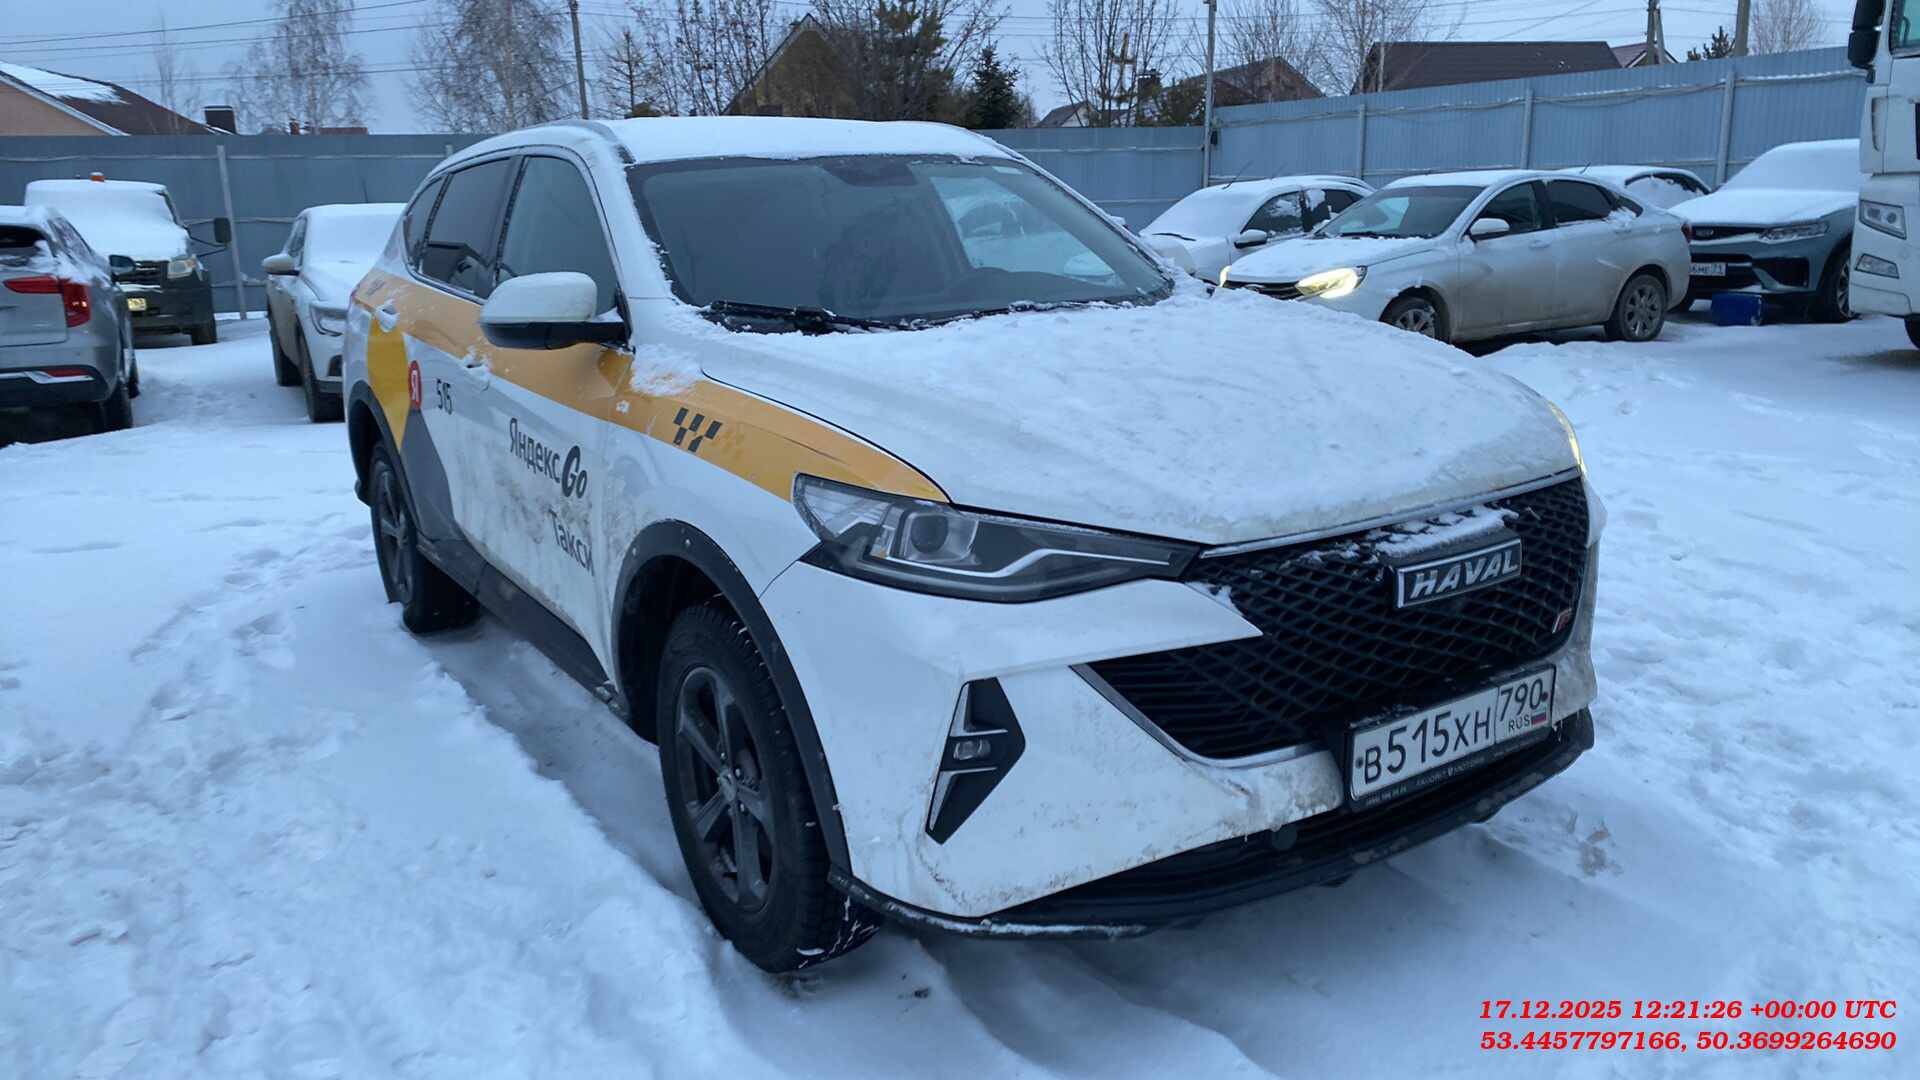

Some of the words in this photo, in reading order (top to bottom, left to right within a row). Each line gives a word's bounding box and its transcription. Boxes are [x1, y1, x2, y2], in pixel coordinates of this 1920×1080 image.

[411, 369, 420, 402] Я
[436, 378, 453, 415] 515
[509, 417, 561, 484] Яндекс
[561, 445, 588, 499] Go
[548, 507, 596, 576] Такси
[1410, 550, 1519, 599] HAVAL
[1364, 707, 1491, 785] В515ХН
[1499, 677, 1545, 722] 790
[1508, 715, 1531, 733] RUS
